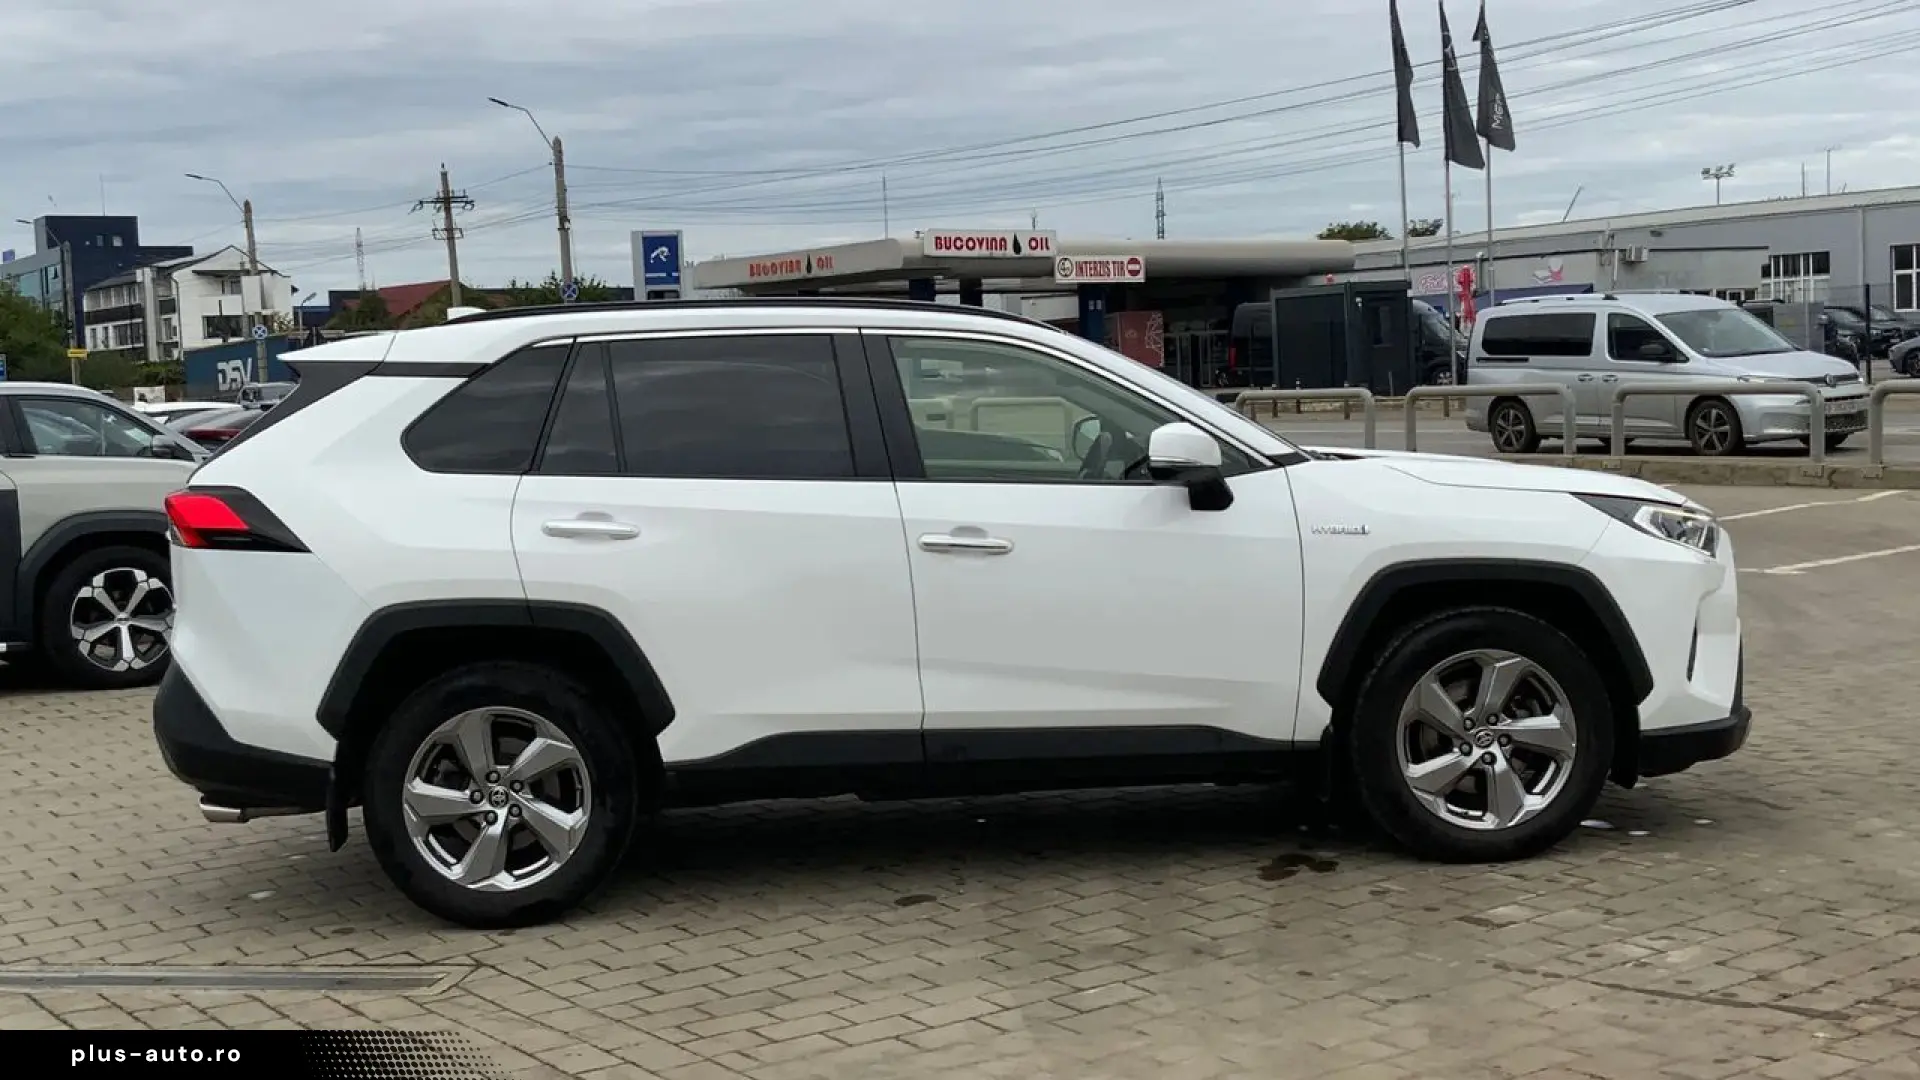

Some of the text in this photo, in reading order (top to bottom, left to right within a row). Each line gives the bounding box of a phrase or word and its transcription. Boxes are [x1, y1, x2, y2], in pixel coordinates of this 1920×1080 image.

[934, 236, 1050, 251] BUCOVINA OIL
[816, 256, 834, 271] OIL
[1111, 260, 1126, 277] TIR
